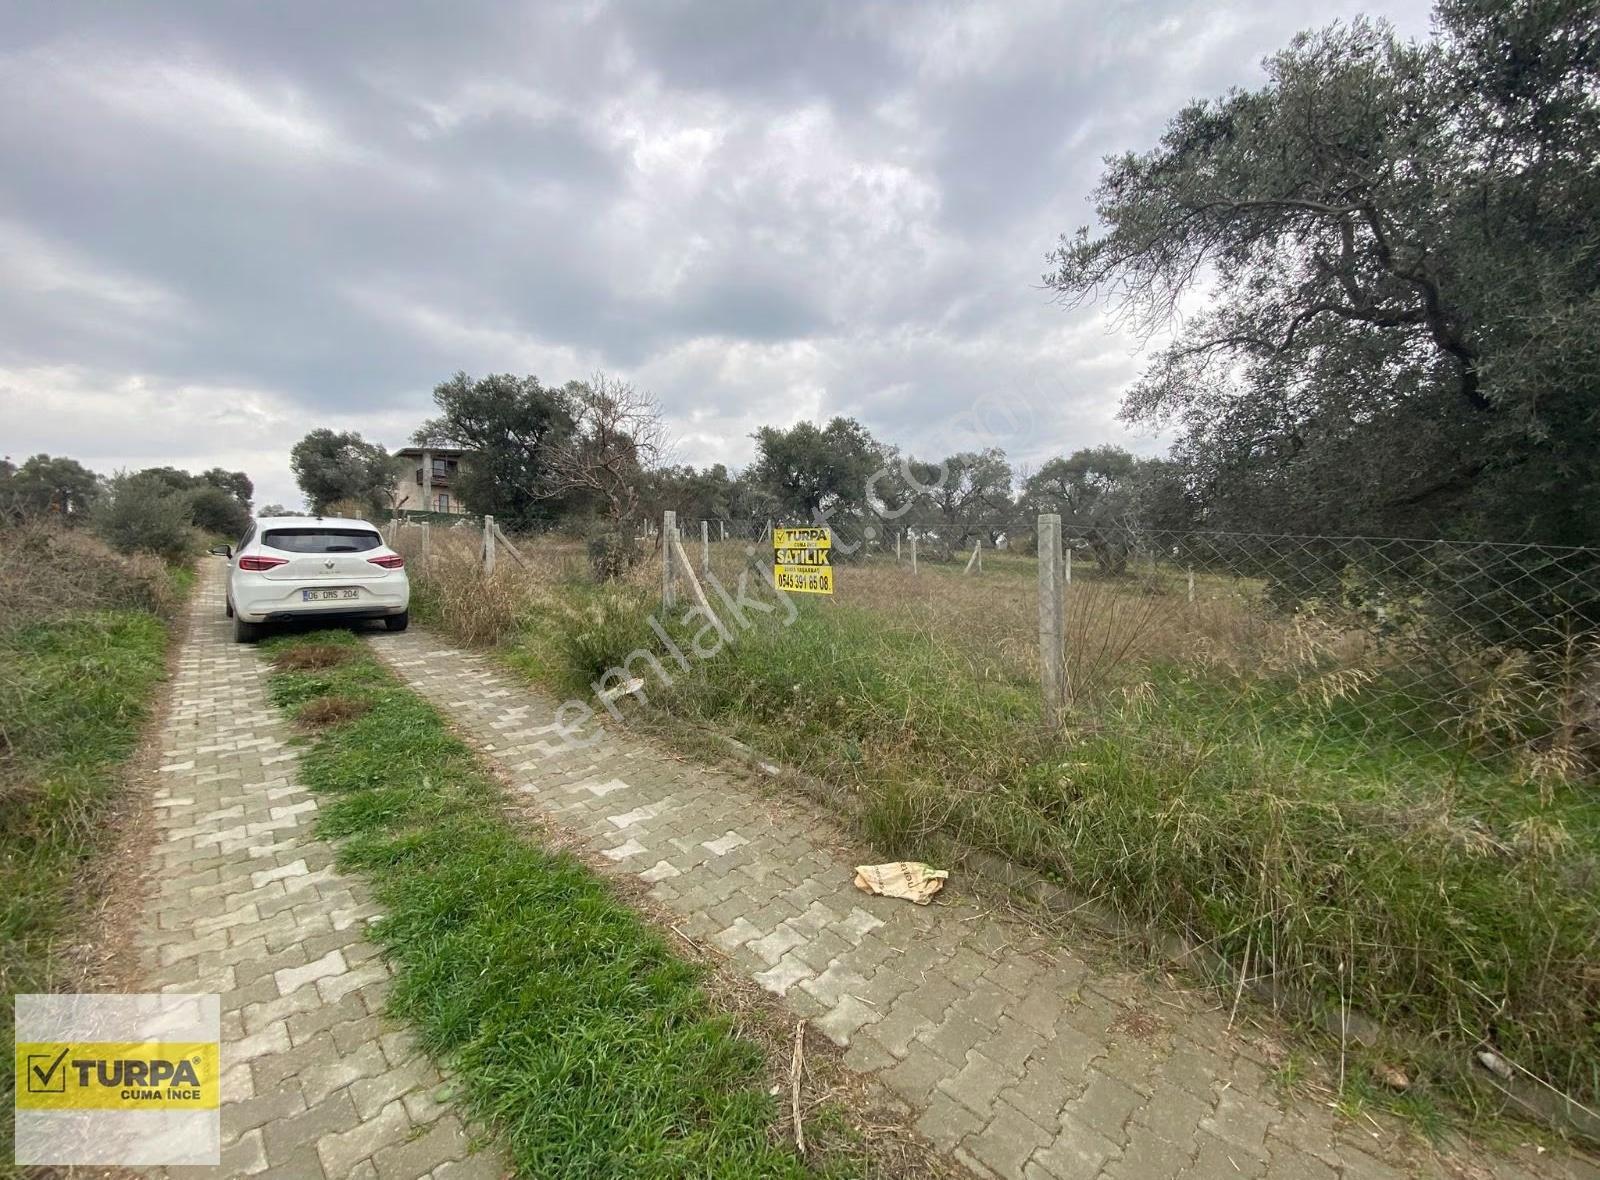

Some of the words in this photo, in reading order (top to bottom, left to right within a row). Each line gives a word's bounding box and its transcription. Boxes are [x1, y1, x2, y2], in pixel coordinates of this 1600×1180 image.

[786, 529, 827, 541] TURPA
[777, 549, 829, 565] SATILIK
[778, 574, 793, 588] 0545
[820, 576, 829, 590] 08
[308, 591, 318, 600] 06
[343, 590, 358, 598] 204
